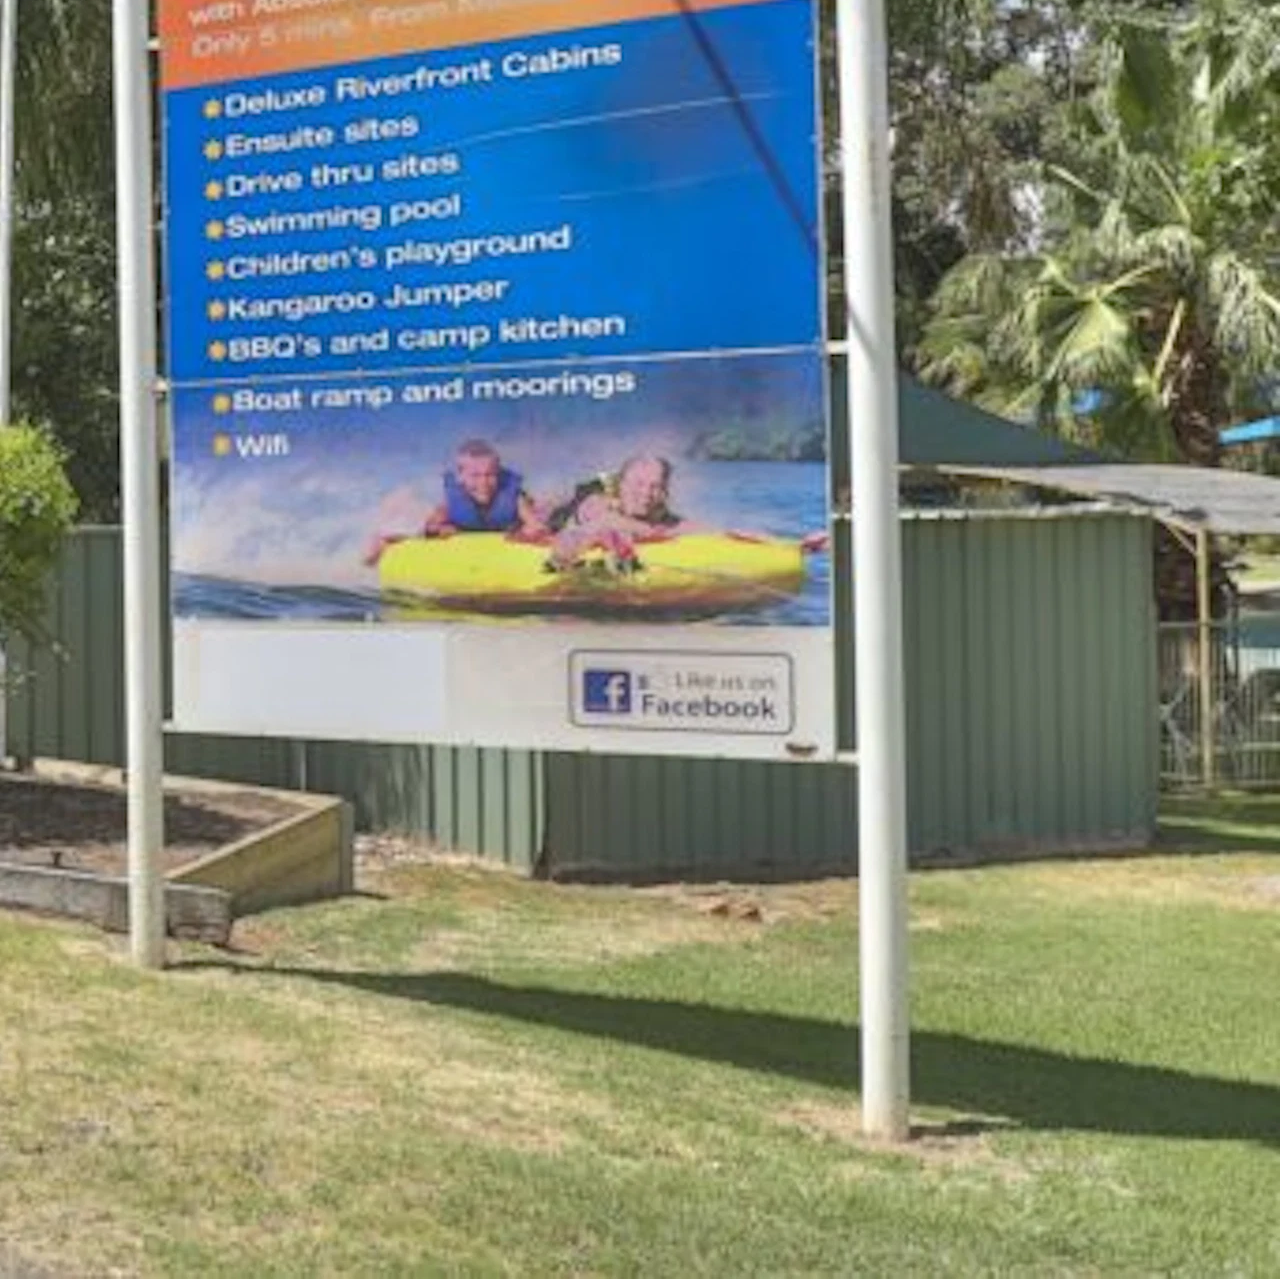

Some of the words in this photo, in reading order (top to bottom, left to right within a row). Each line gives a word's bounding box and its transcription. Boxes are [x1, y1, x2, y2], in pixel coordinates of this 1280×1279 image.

[189, 0, 246, 27] with
[192, 29, 251, 59] Only
[224, 85, 327, 118] Deluxe
[336, 59, 492, 102] Riverfront
[501, 42, 622, 79] Cabins
[225, 126, 335, 158] Ensuite
[344, 113, 420, 143] sites
[226, 166, 303, 199] Drive
[310, 155, 374, 186] thru
[381, 151, 461, 180] sites
[226, 202, 382, 241] Swimming
[389, 192, 461, 228] pool
[226, 245, 377, 280] Children's
[386, 225, 571, 269] playground
[227, 289, 376, 322] Kangaroo
[383, 278, 510, 309] Jumper
[228, 334, 322, 362] BBQ's
[328, 328, 389, 355] and
[397, 322, 491, 351] camp
[499, 313, 626, 343] kitchen
[232, 387, 303, 412] Boat
[310, 385, 393, 409] ramp
[401, 377, 464, 403] and
[471, 368, 637, 400] moorings
[235, 434, 290, 459] Wifi
[675, 671, 715, 690] Like
[720, 674, 744, 691] us
[749, 676, 777, 691] on
[642, 694, 778, 720] Facebook
